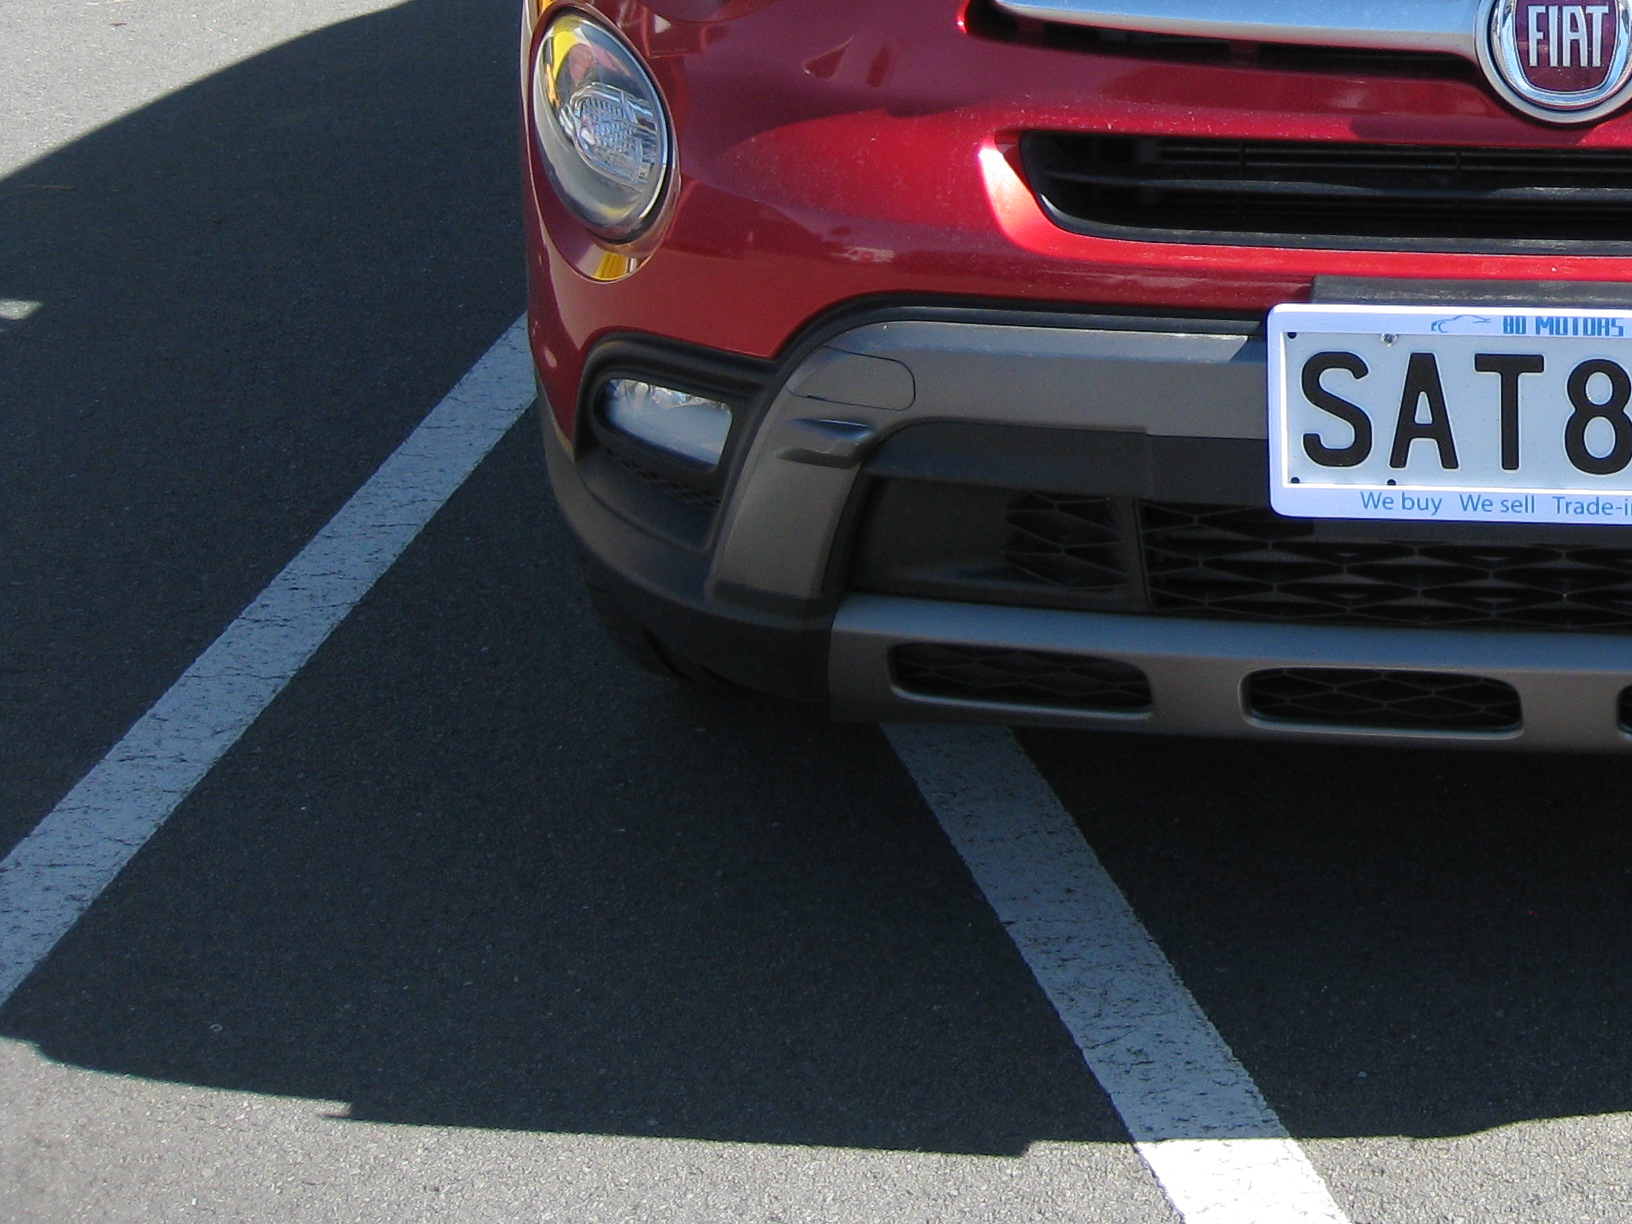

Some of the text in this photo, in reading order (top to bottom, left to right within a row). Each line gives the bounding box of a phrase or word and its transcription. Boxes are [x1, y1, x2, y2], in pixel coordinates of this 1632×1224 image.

[1527, 4, 1610, 68] FIAT
[1535, 316, 1624, 337] MOTORS
[1360, 491, 1395, 511] We
[1402, 493, 1443, 517] buy
[1459, 494, 1494, 514] We
[1500, 495, 1536, 514] sell
